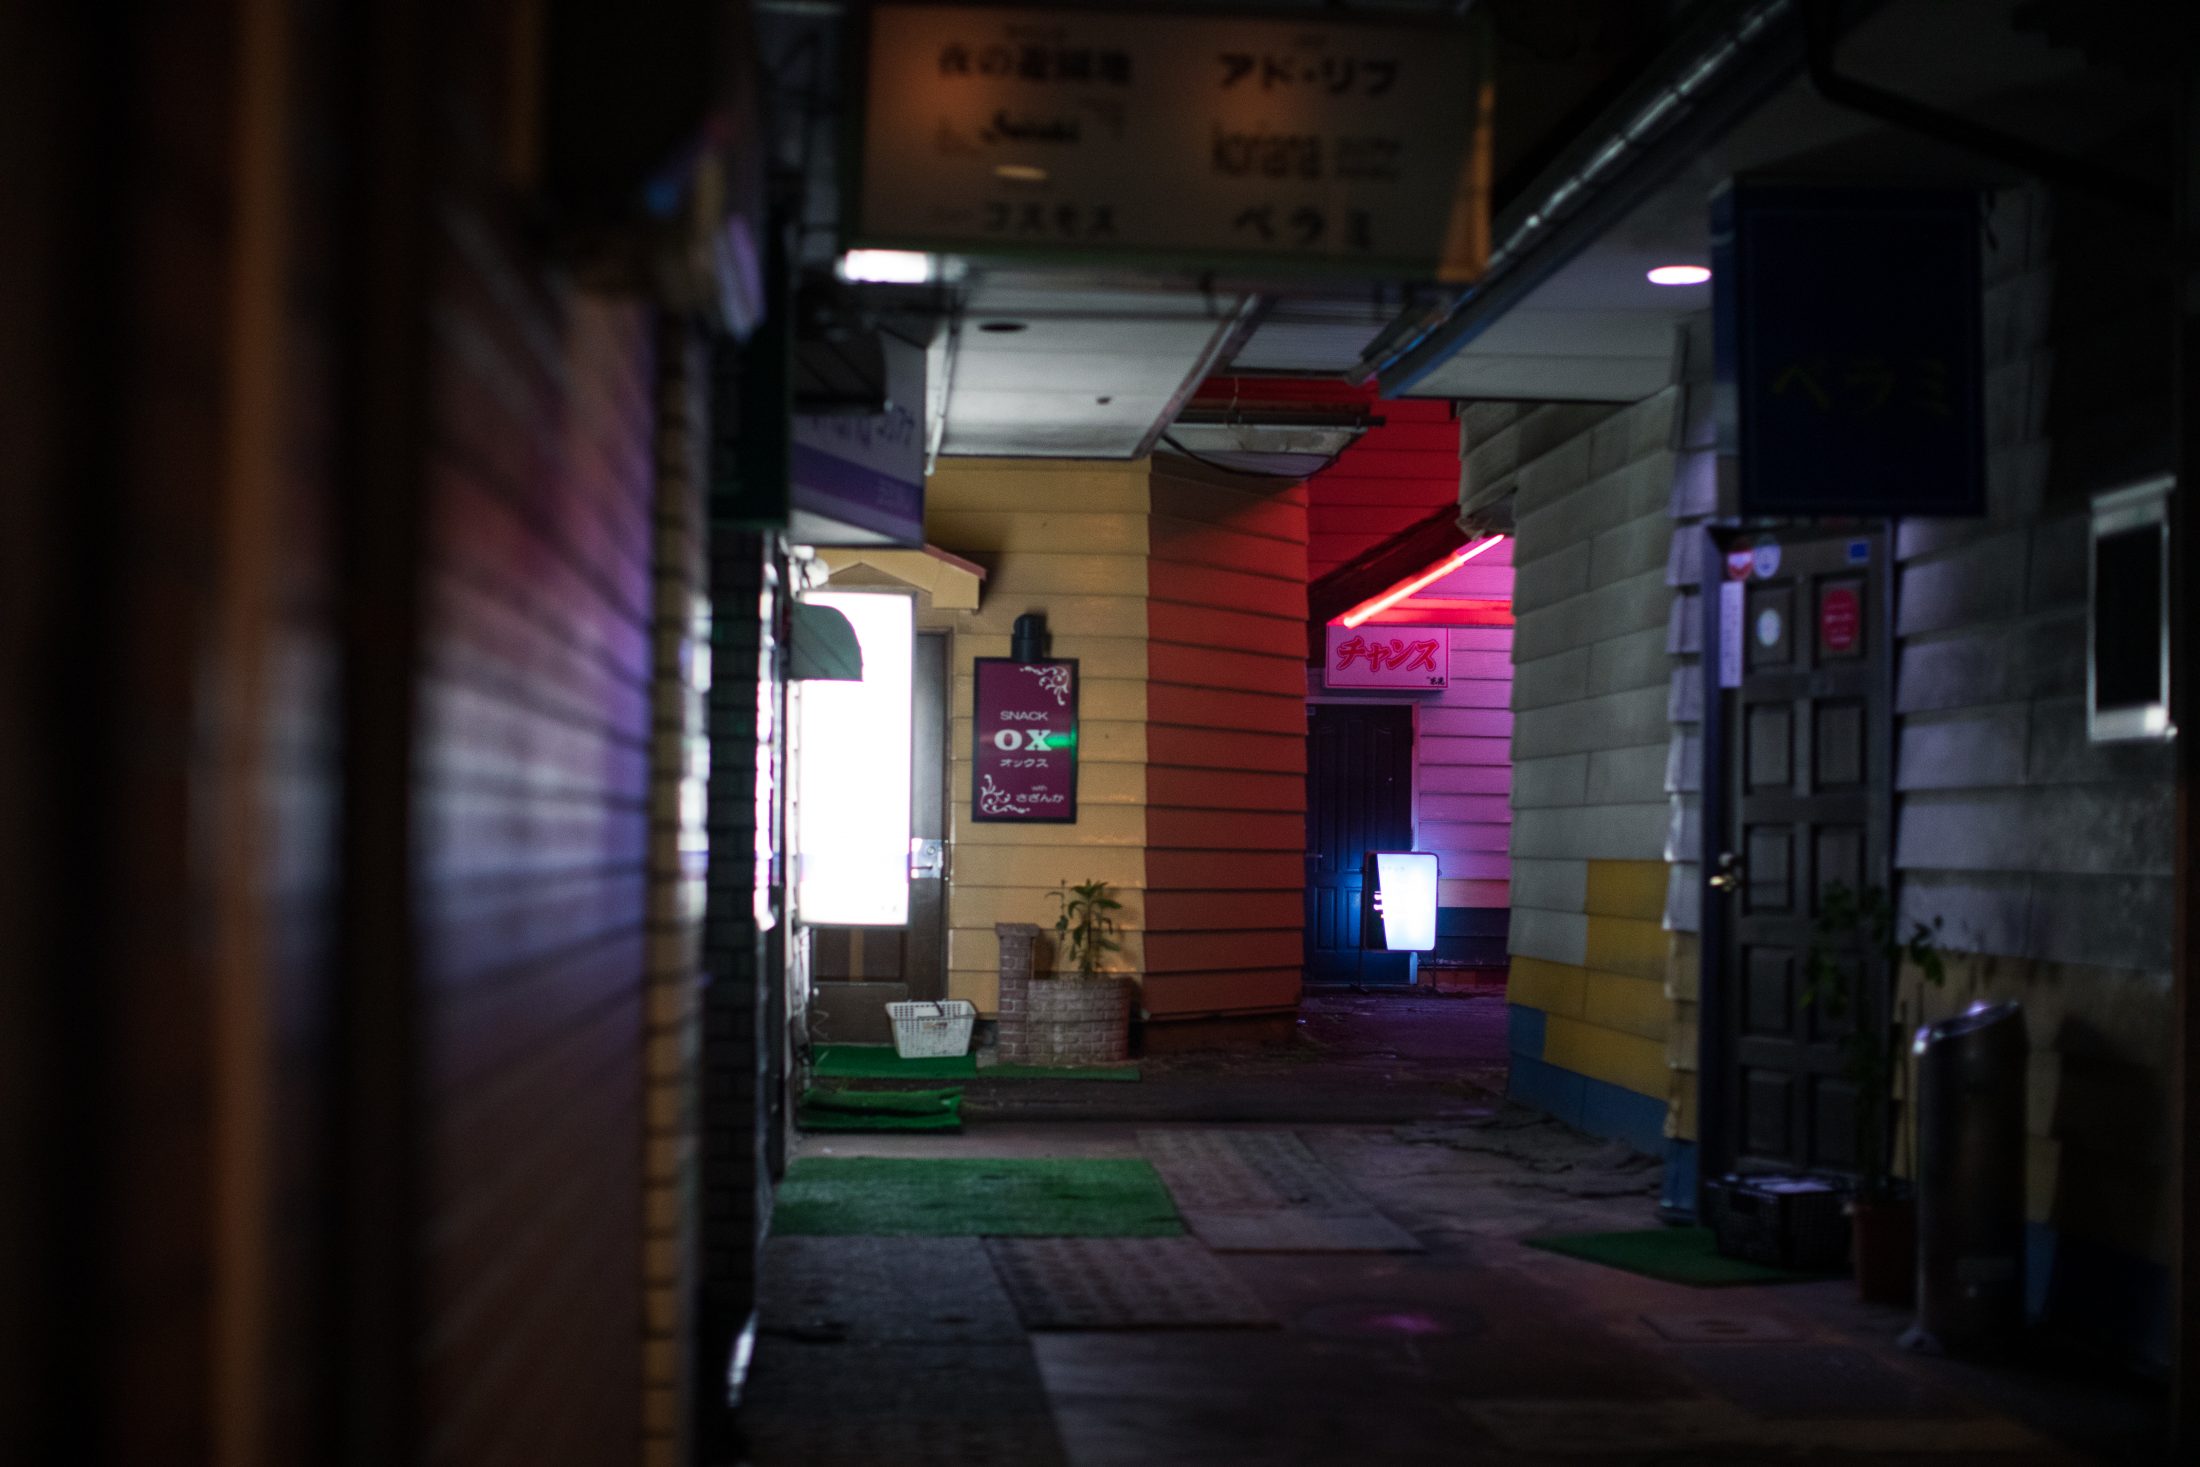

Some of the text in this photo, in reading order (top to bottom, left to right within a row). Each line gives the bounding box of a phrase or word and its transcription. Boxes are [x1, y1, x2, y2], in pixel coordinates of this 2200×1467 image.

[1336, 635, 1439, 672] チャンス
[1000, 711, 1048, 721] SNACK
[994, 729, 1052, 751] OX
